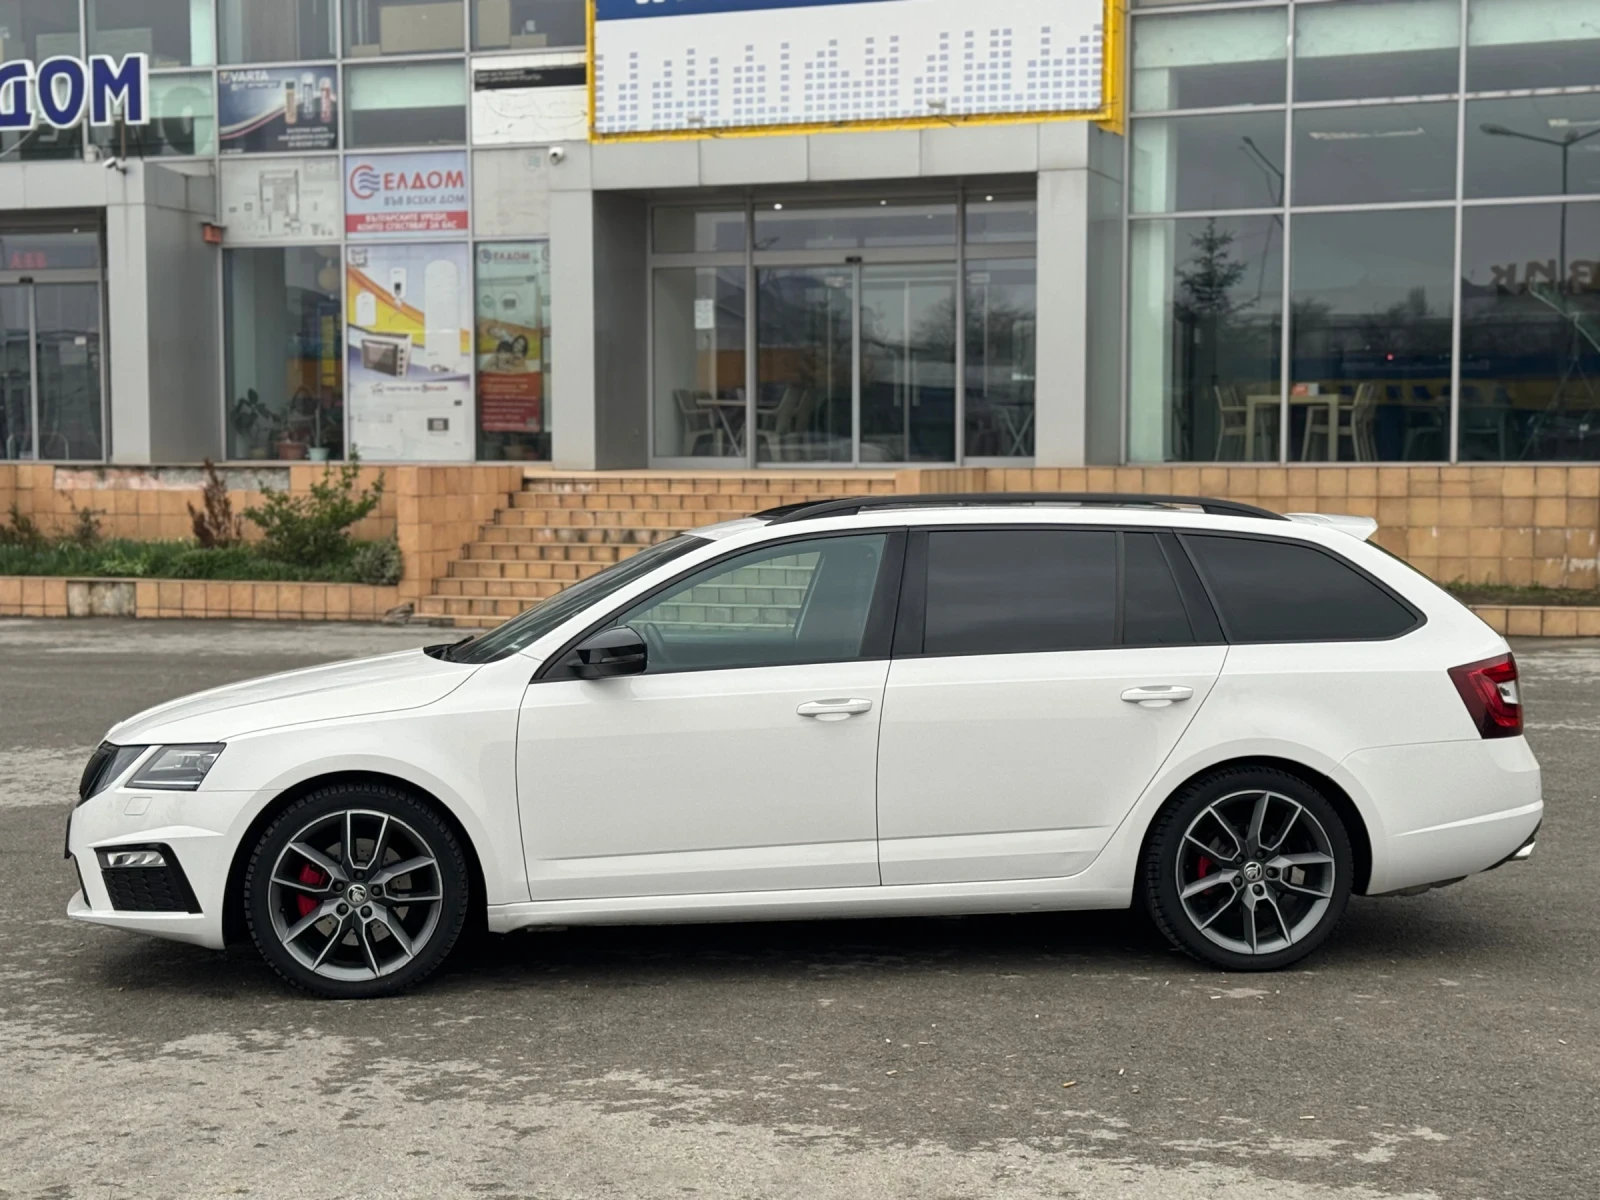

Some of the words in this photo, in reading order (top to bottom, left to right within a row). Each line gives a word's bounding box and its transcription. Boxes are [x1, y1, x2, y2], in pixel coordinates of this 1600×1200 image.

[230, 70, 269, 82] VARTA
[383, 169, 465, 190] ЕЛДОМ
[384, 195, 404, 206] ВЪВ
[406, 194, 437, 205] ВСЕКИ
[439, 194, 465, 204] ДОМ
